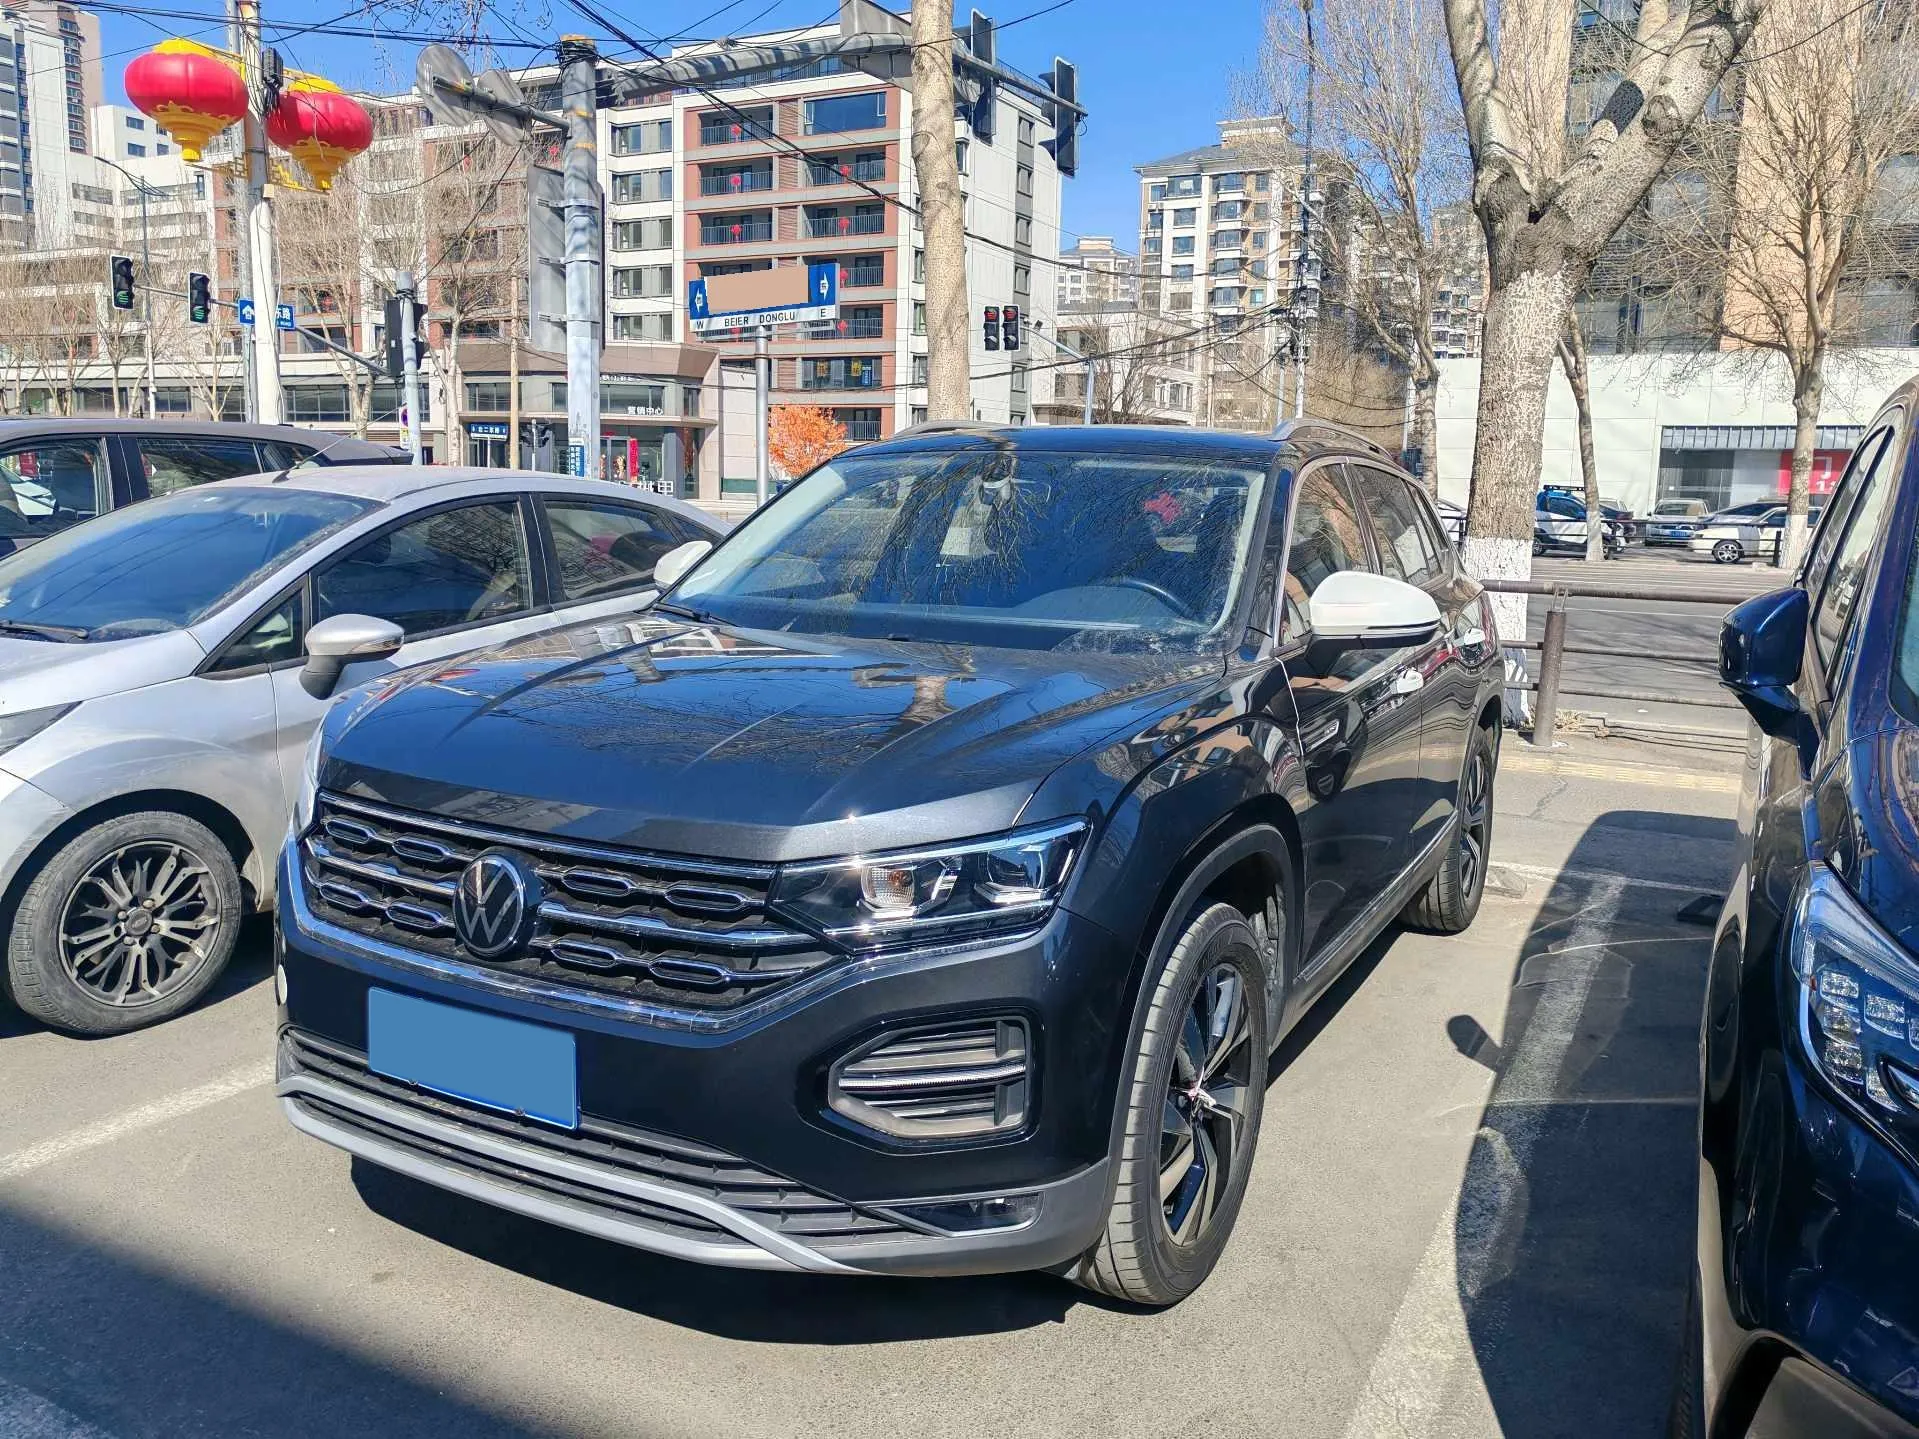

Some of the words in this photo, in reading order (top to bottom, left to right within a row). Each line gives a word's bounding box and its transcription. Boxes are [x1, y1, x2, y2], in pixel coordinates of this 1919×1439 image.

[696, 321, 705, 329] W
[724, 316, 749, 327] BEIER
[759, 311, 796, 324] DONGLU
[820, 308, 827, 318] E
[627, 406, 664, 416] 营销中心
